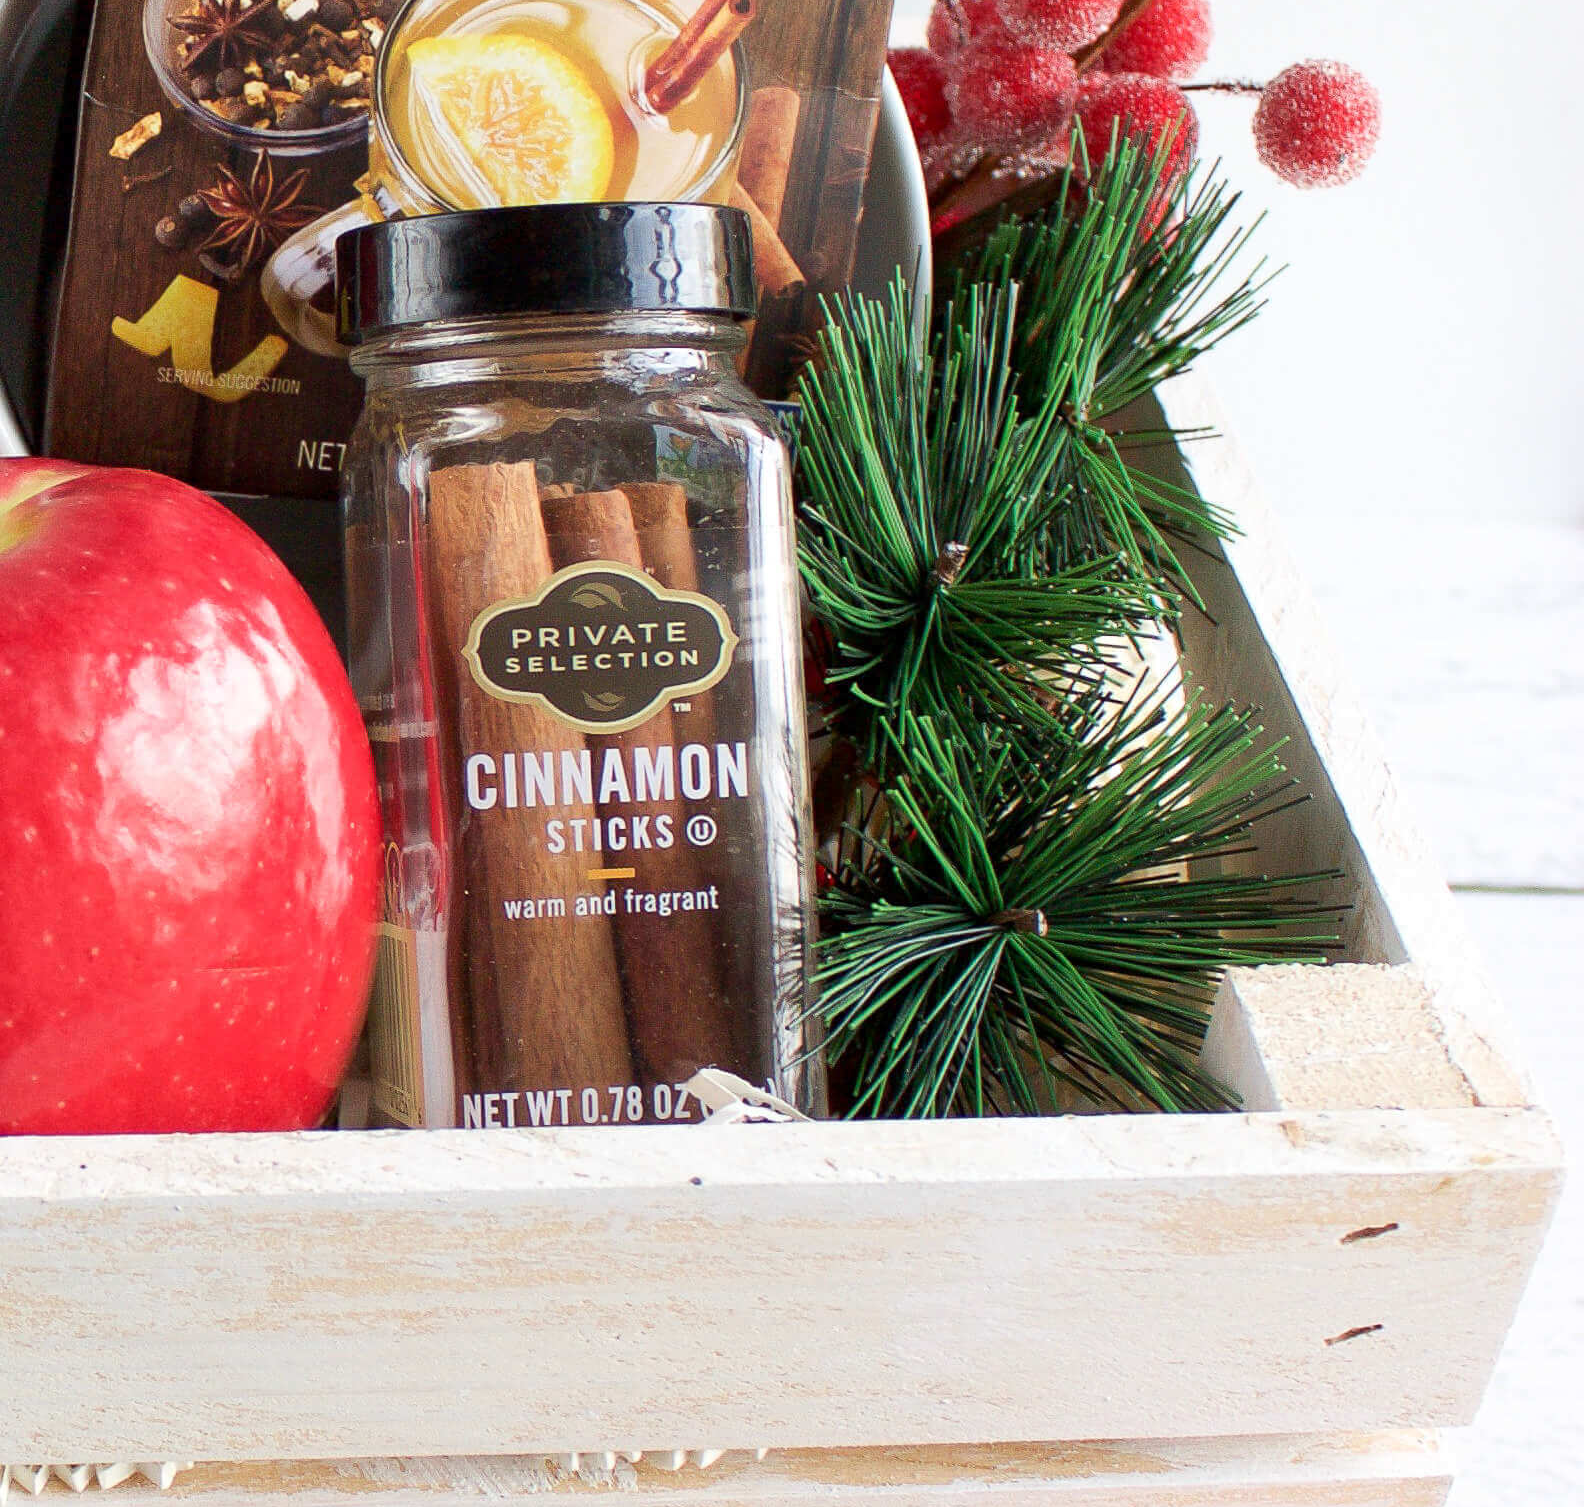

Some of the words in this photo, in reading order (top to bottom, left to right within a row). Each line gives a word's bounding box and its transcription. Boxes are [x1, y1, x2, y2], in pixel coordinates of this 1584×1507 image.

[157, 366, 215, 387] SERVING
[218, 372, 301, 396] SUGGESTION
[511, 621, 688, 649] PRIVATE
[505, 649, 699, 674] SELECTION
[466, 742, 749, 811] CINNAMON
[546, 814, 674, 854] STICKS
[504, 895, 566, 920] warm
[575, 890, 616, 915] and
[624, 884, 719, 917] fragrant
[463, 1093, 519, 1130] NET
[526, 1089, 574, 1127] WT
[581, 1086, 644, 1124] 0.78
[654, 1084, 692, 1120] OZ
